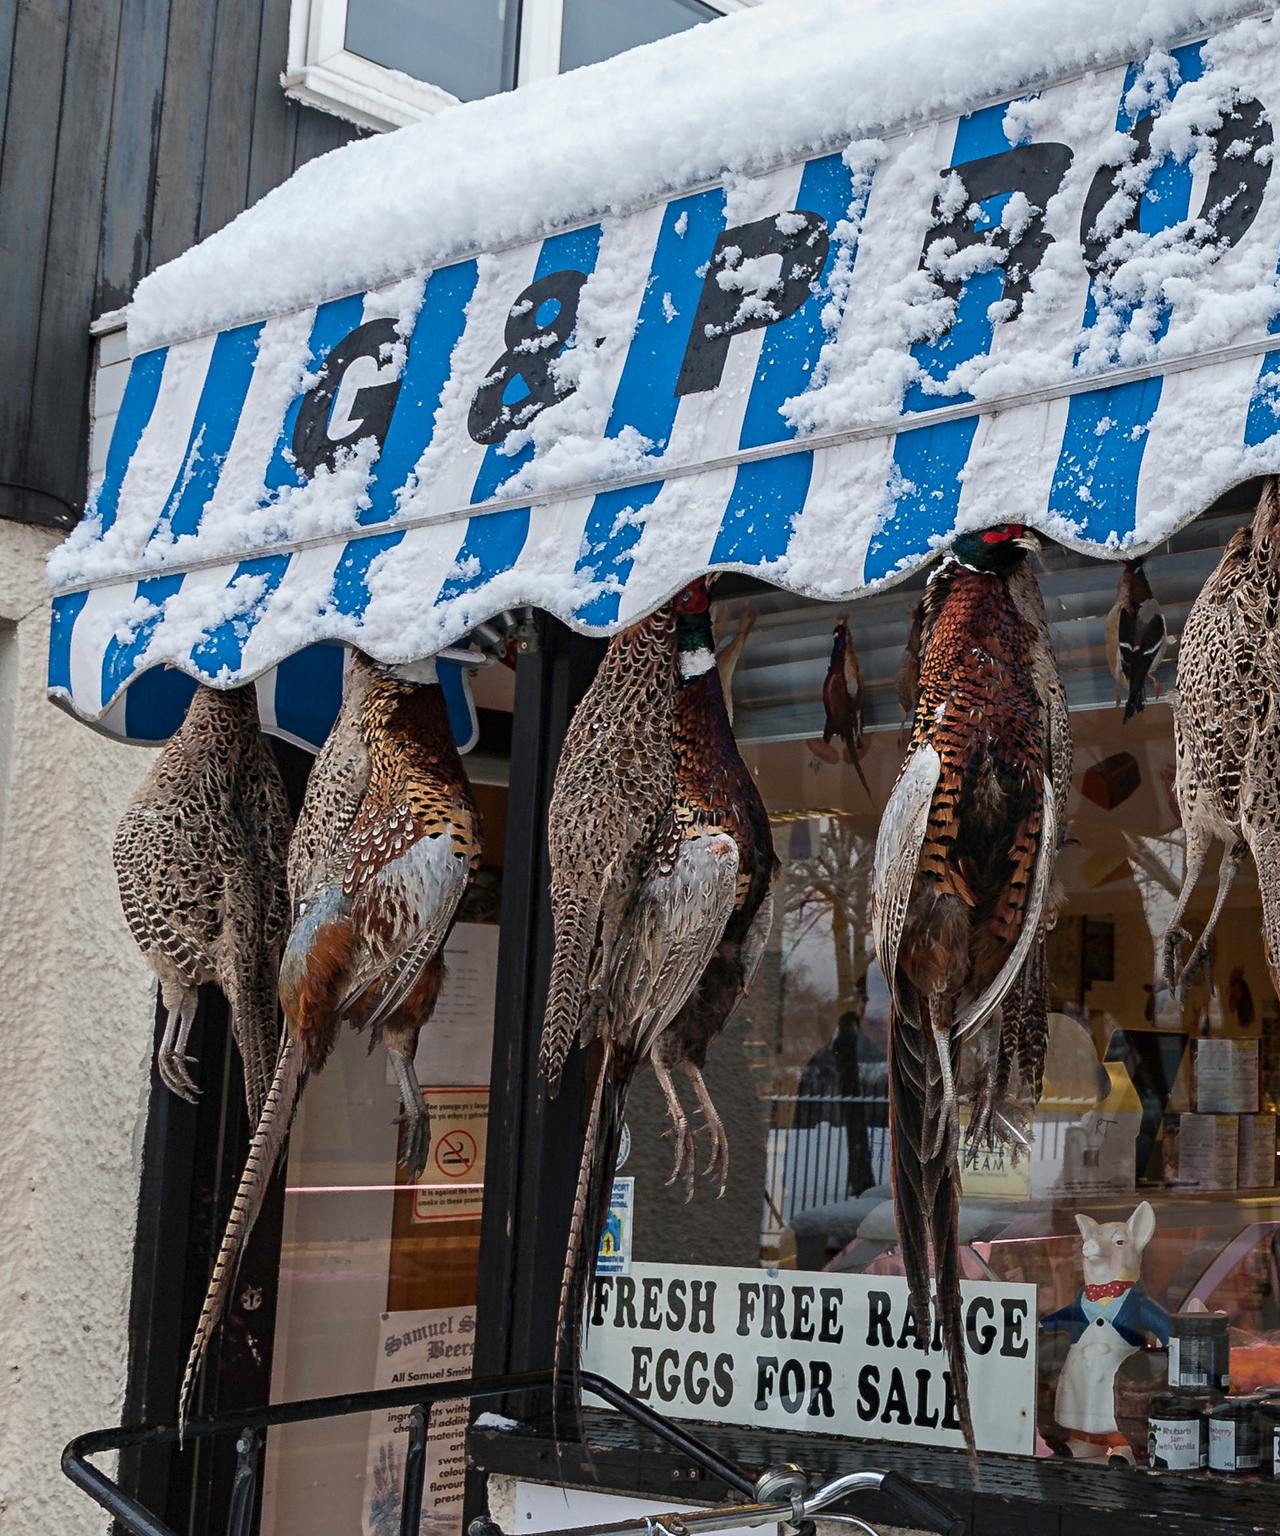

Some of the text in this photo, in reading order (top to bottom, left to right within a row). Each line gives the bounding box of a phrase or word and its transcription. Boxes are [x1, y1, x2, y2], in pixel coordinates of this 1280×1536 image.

[293, 318, 410, 480] G
[467, 270, 598, 447] &
[675, 209, 830, 398] P
[592, 1276, 717, 1334] FRESH
[737, 1283, 843, 1344] FREE
[384, 1317, 453, 1357] Samuel
[392, 1368, 445, 1383] All Samuel
[632, 1346, 734, 1407] EGGS
[754, 1356, 835, 1418] FOR
[428, 1429, 464, 1442] materia
[438, 1456, 465, 1466] swee
[440, 1467, 465, 1478] colou
